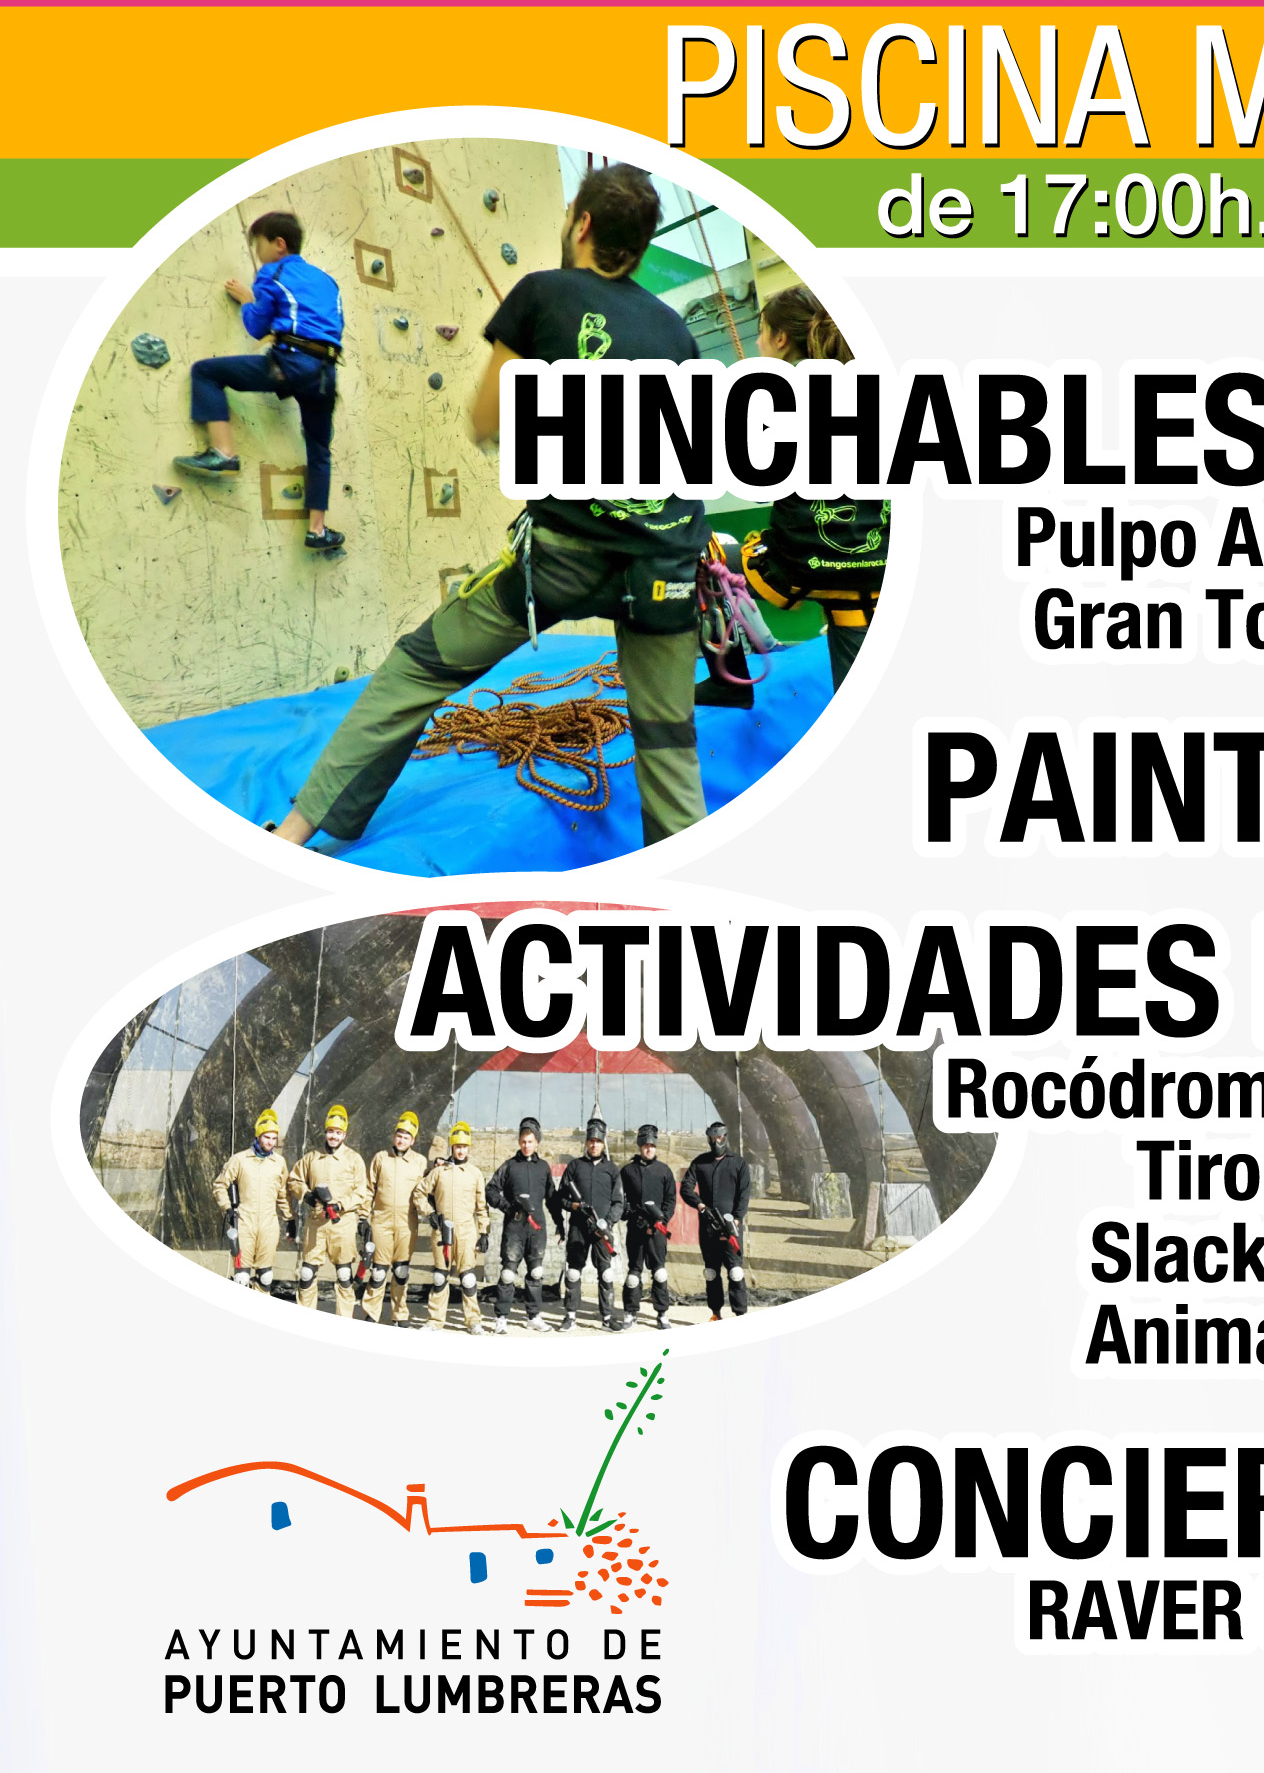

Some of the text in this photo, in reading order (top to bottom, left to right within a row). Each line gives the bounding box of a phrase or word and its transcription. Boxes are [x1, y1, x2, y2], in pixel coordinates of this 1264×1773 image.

[668, 24, 1148, 145] PISCINA
[879, 174, 971, 234] de
[1019, 507, 1195, 580] Pulpo
[1035, 588, 1181, 649] Gran
[411, 924, 1218, 1037] ACTIVIDADES
[1030, 1580, 1243, 1640] RAVER
[165, 1629, 660, 1659] AYUNTAMIENTO DE
[166, 1675, 661, 1713] PUERTO LUMBRERAS
